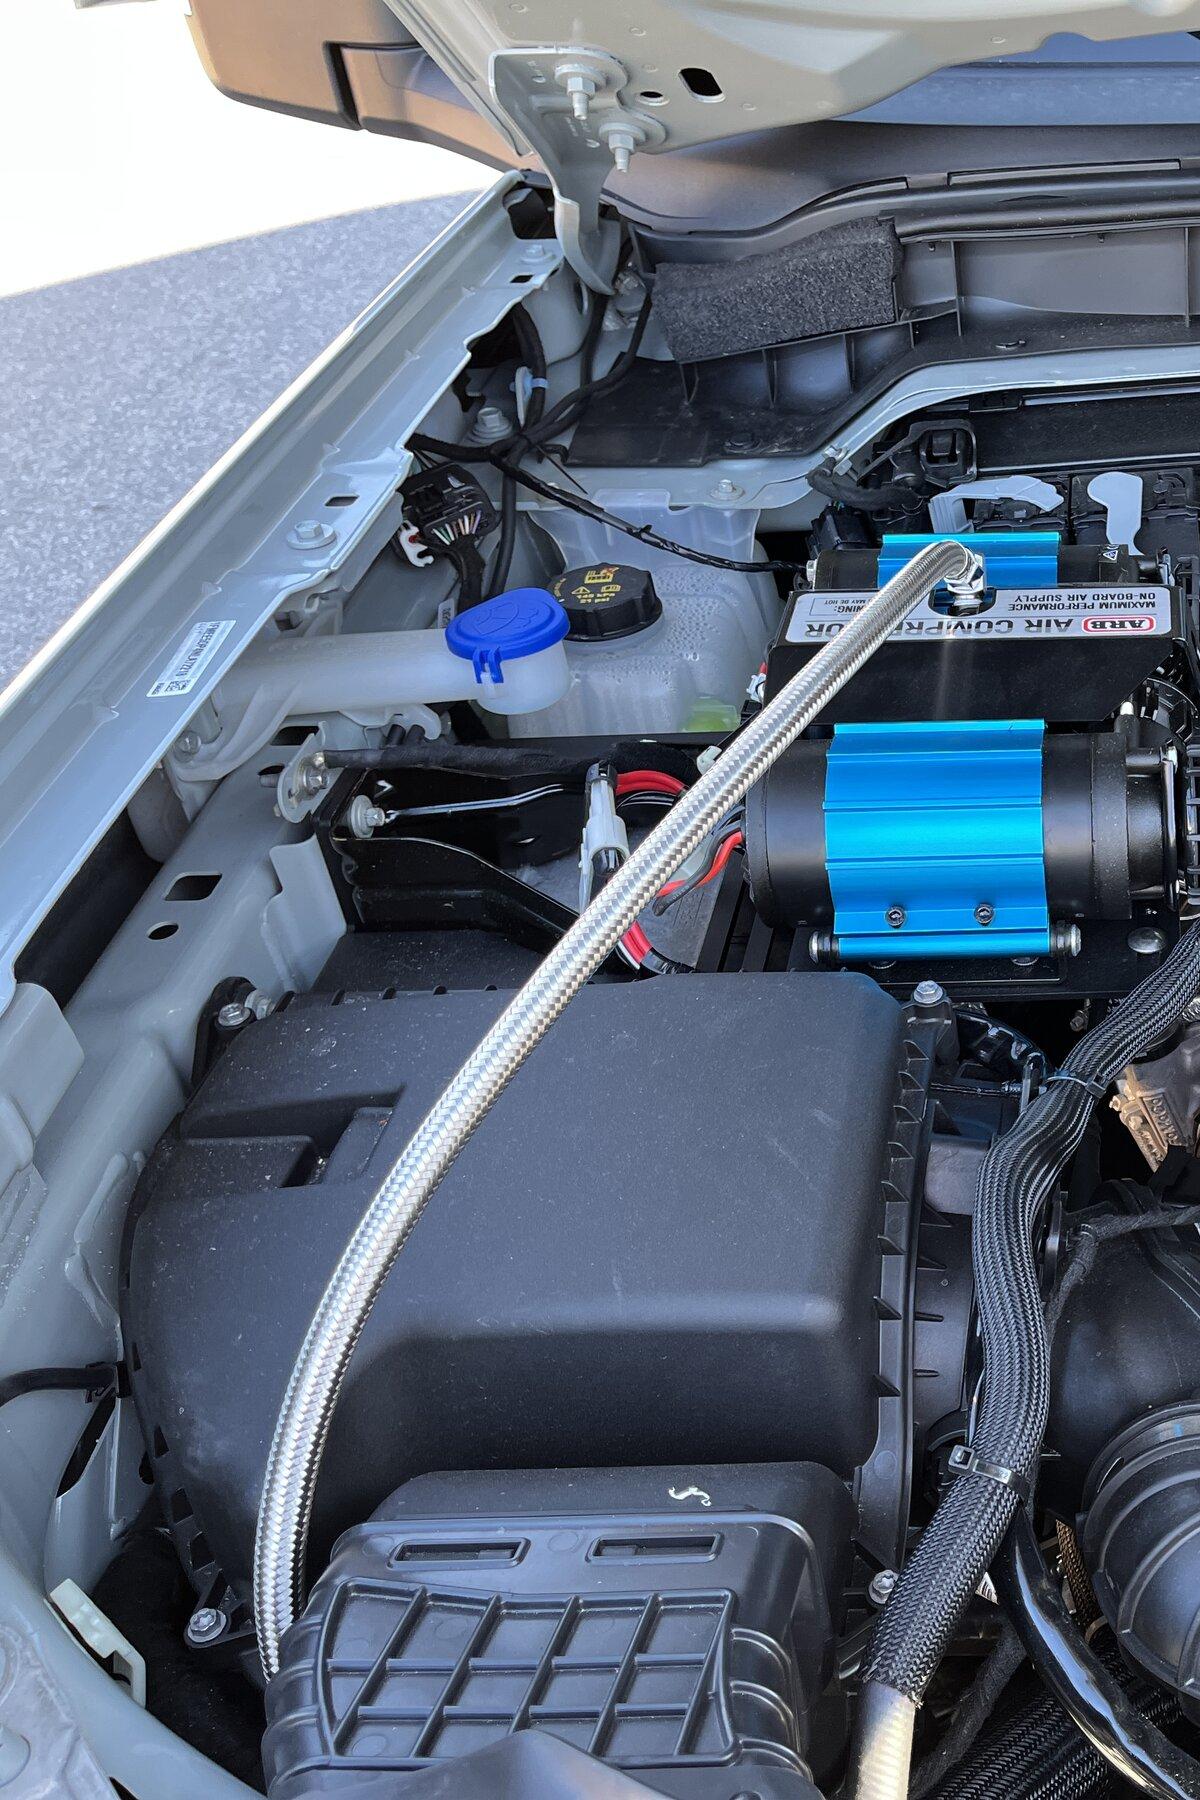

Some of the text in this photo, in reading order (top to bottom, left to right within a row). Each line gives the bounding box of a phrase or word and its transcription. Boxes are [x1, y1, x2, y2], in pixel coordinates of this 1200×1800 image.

[1014, 594, 1062, 602] SUPPLY
[1092, 592, 1156, 601] ON-BOARD
[1008, 601, 1156, 611] MAXIMUM PERFORMANCE
[1024, 618, 1074, 633] AIR
[1090, 619, 1146, 630] ARB
